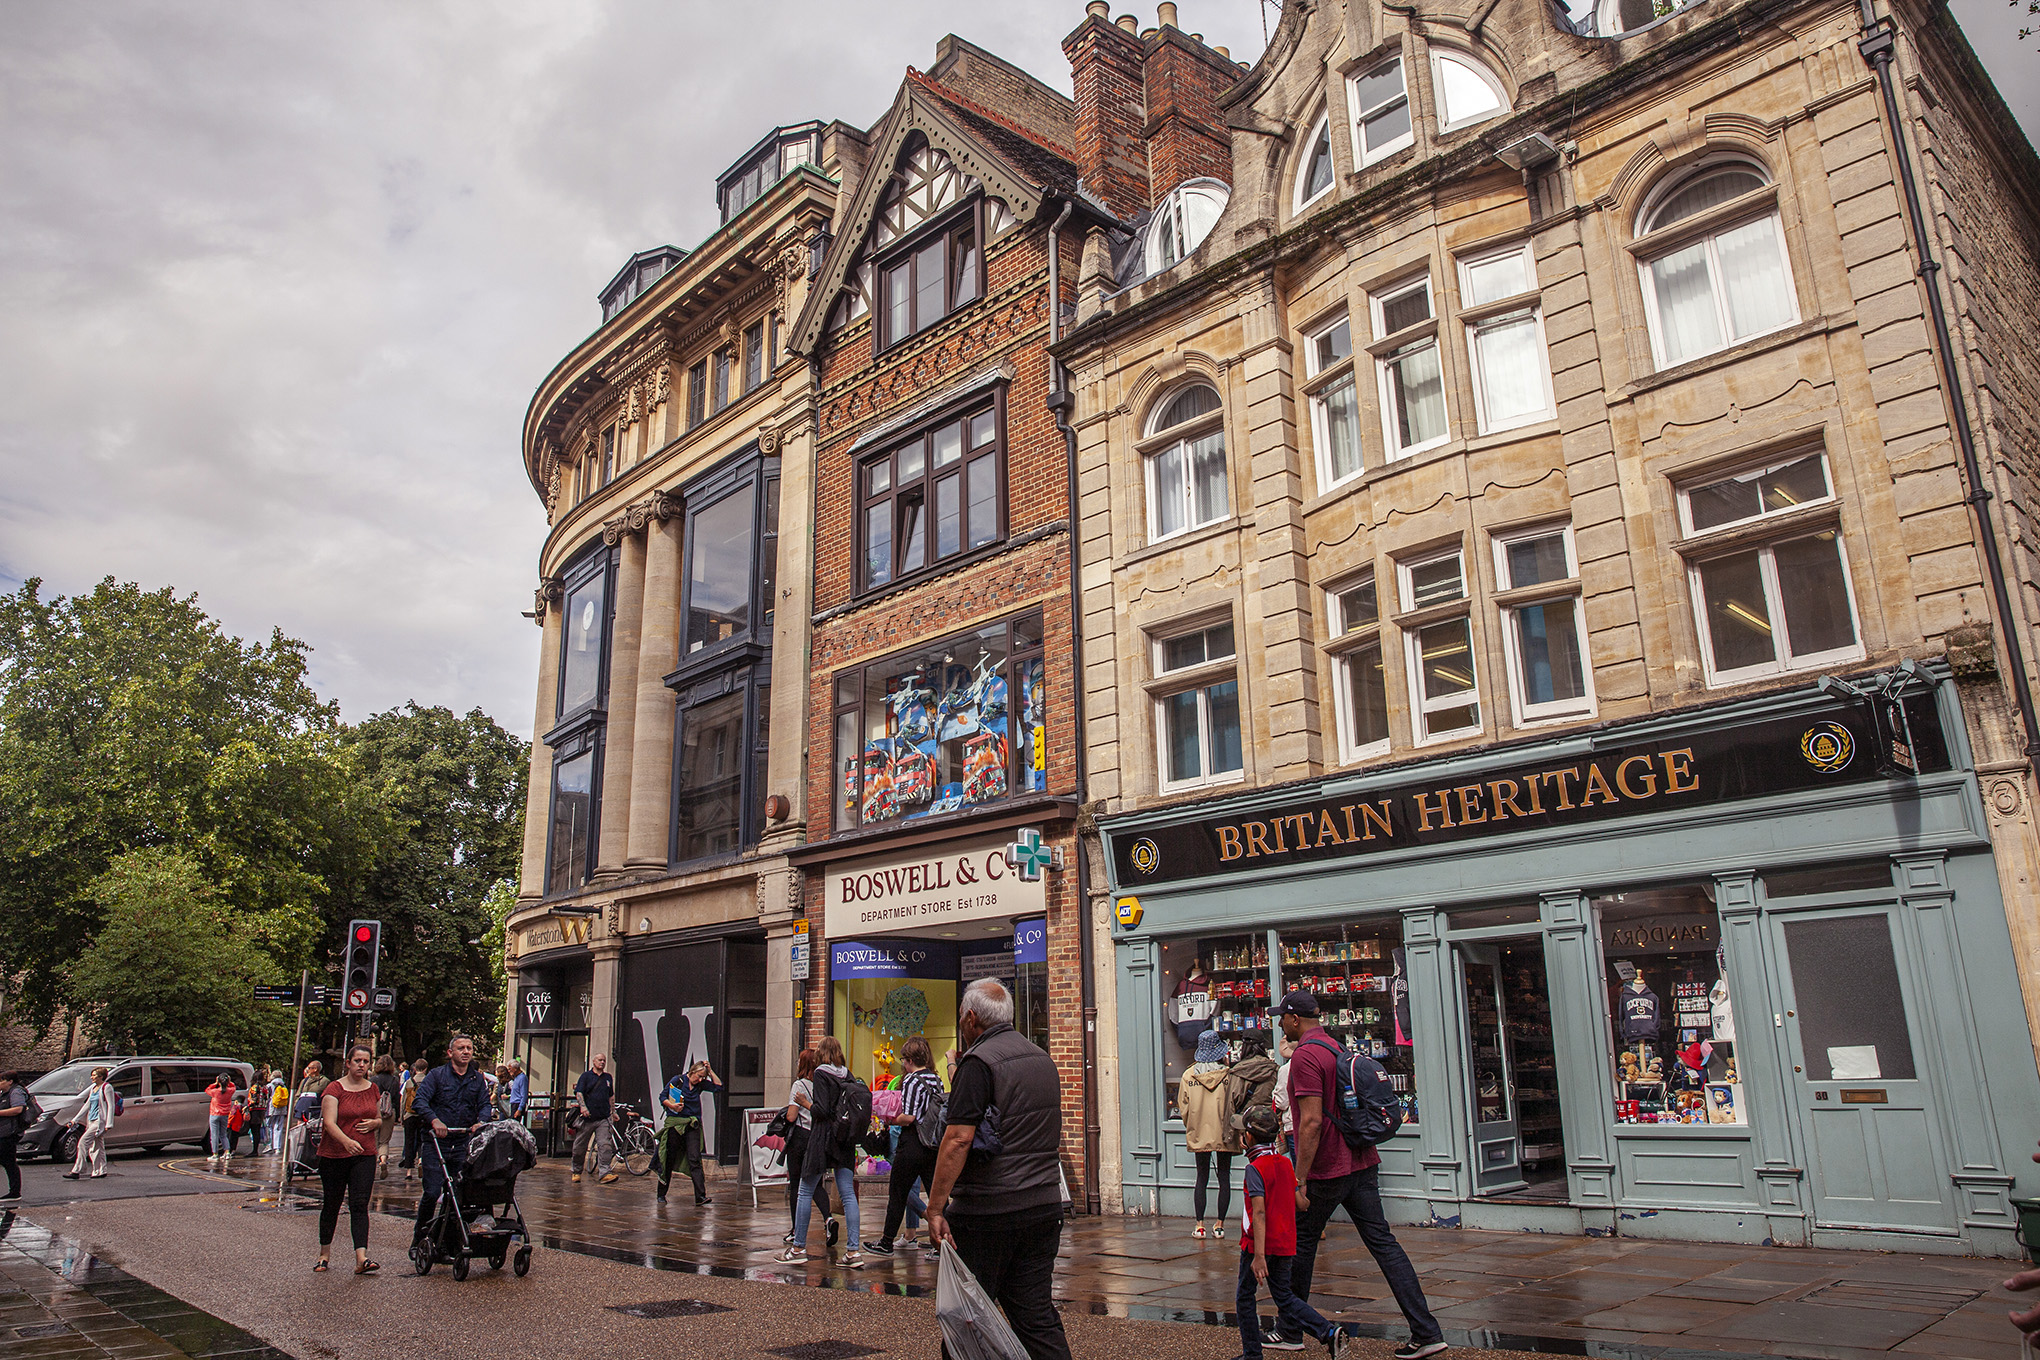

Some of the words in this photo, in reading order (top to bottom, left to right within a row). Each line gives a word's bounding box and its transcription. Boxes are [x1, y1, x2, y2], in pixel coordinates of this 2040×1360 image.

[1215, 799, 1393, 862] BRITAIN
[1413, 747, 1700, 832] HERITAGE
[841, 861, 951, 904] BOSWELL
[956, 856, 979, 886] &
[861, 905, 918, 922] DEPARTMENT
[921, 900, 952, 915] STORE
[958, 898, 973, 909] Est
[976, 893, 998, 907] 1738
[1120, 906, 1131, 916] ADT
[555, 916, 593, 945] W
[836, 950, 894, 964] BOSWELL
[897, 950, 909, 962] &
[526, 992, 551, 1003] Café
[1626, 997, 1654, 1011] OXFORD
[526, 1004, 551, 1024] W
[1815, 1091, 1829, 1101] 30
